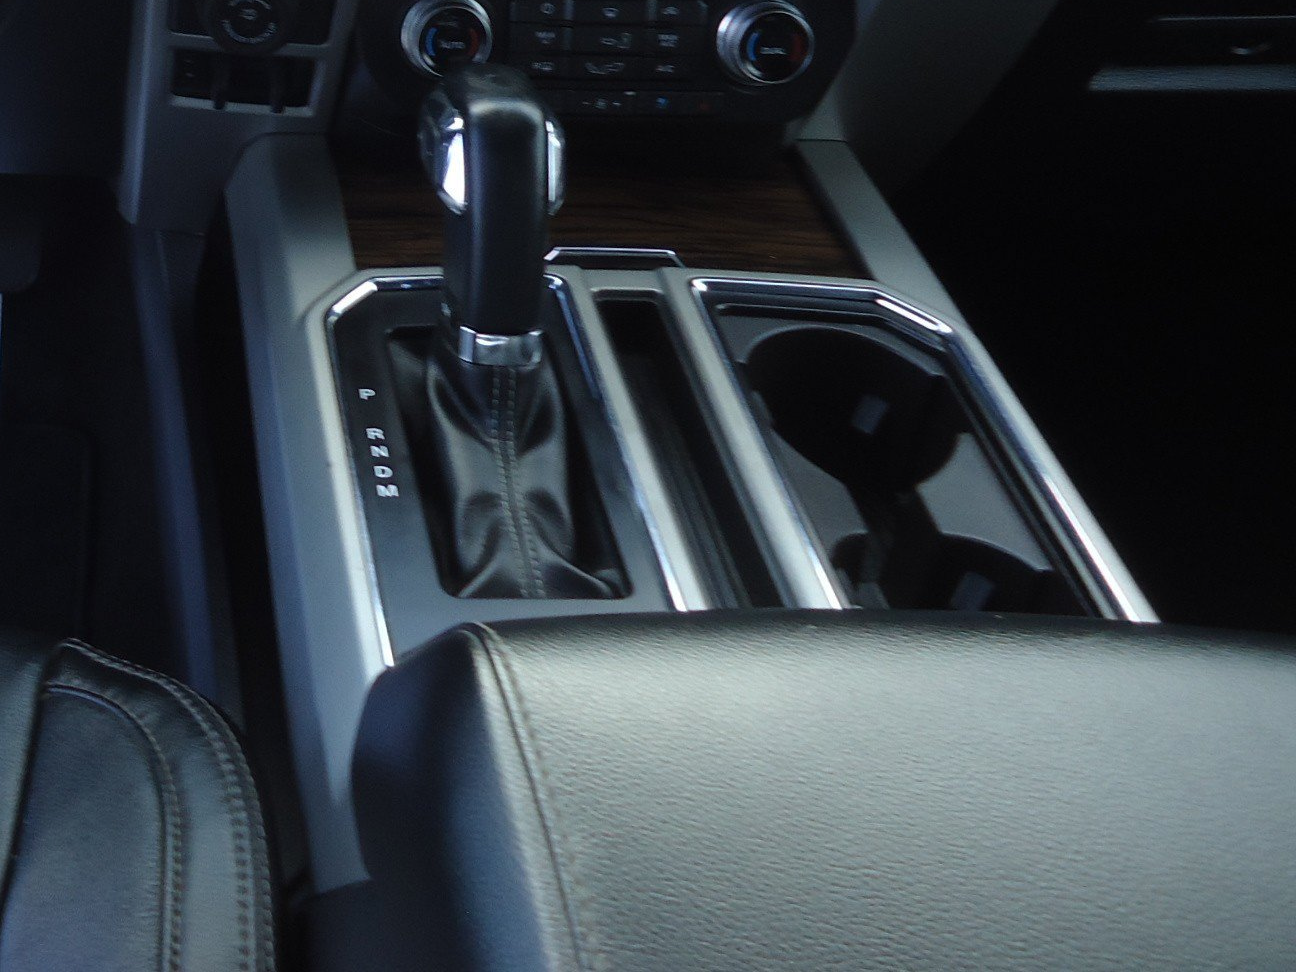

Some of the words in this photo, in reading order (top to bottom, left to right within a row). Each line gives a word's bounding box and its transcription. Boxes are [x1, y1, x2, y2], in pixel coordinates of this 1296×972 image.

[358, 388, 376, 400] P
[365, 427, 385, 440] R
[370, 445, 389, 457] N
[373, 465, 393, 478] D
[376, 484, 399, 497] M
